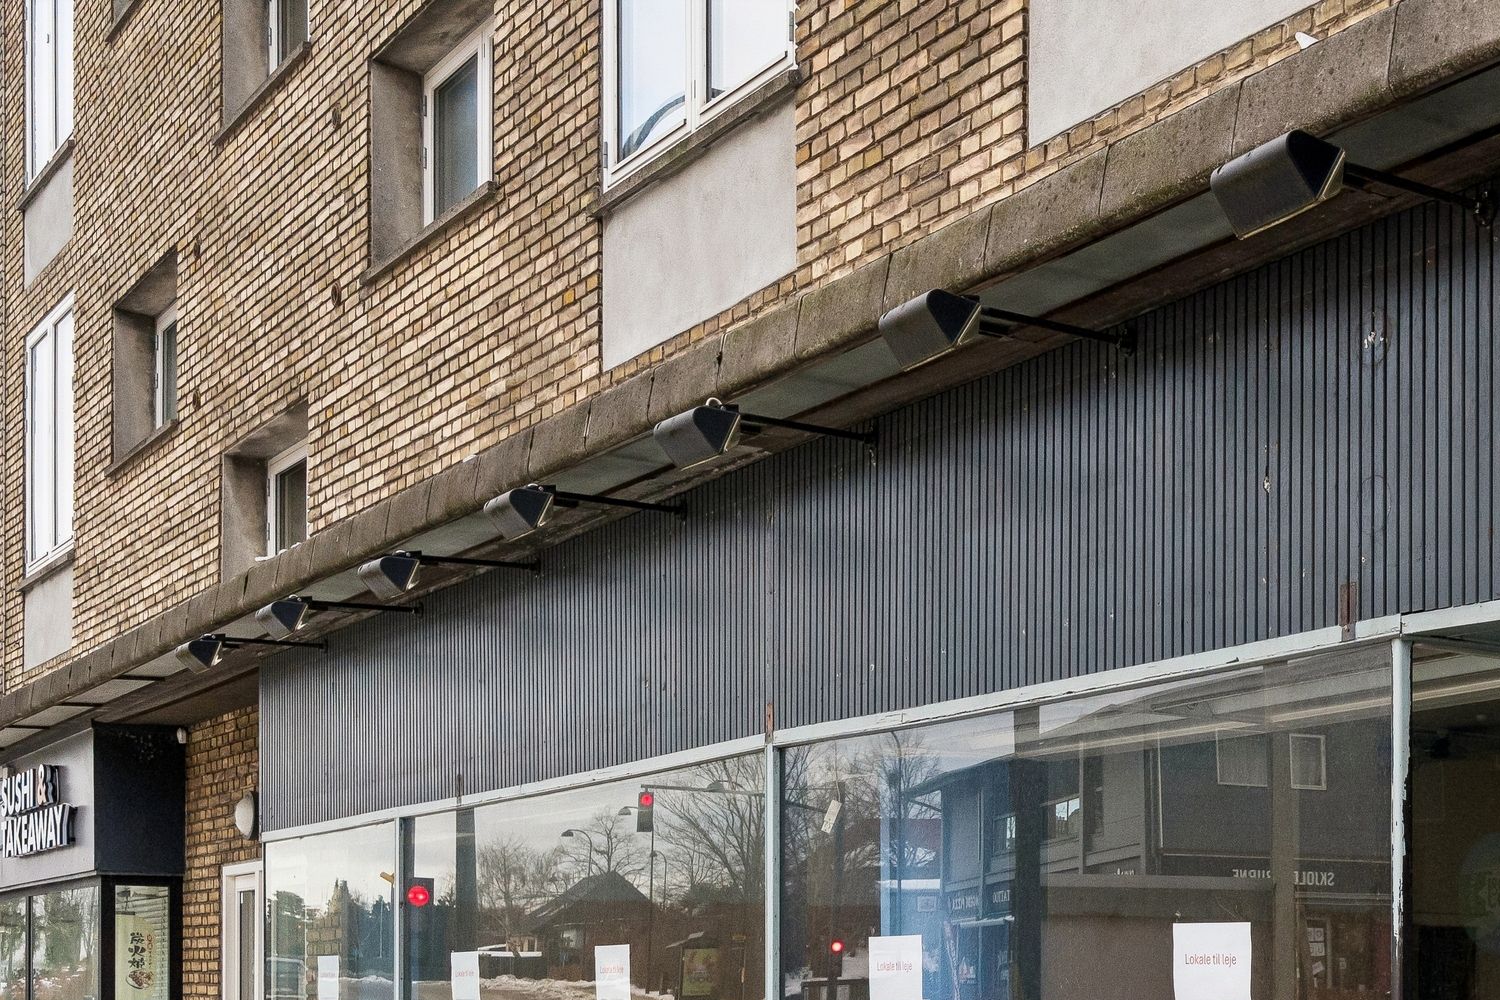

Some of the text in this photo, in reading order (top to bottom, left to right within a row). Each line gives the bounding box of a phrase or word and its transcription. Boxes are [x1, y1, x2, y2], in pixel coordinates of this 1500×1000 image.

[1, 763, 48, 817] SUSHI &
[1, 804, 64, 859] TAKEAWAY
[1185, 953, 1237, 968] Lokale til leje
